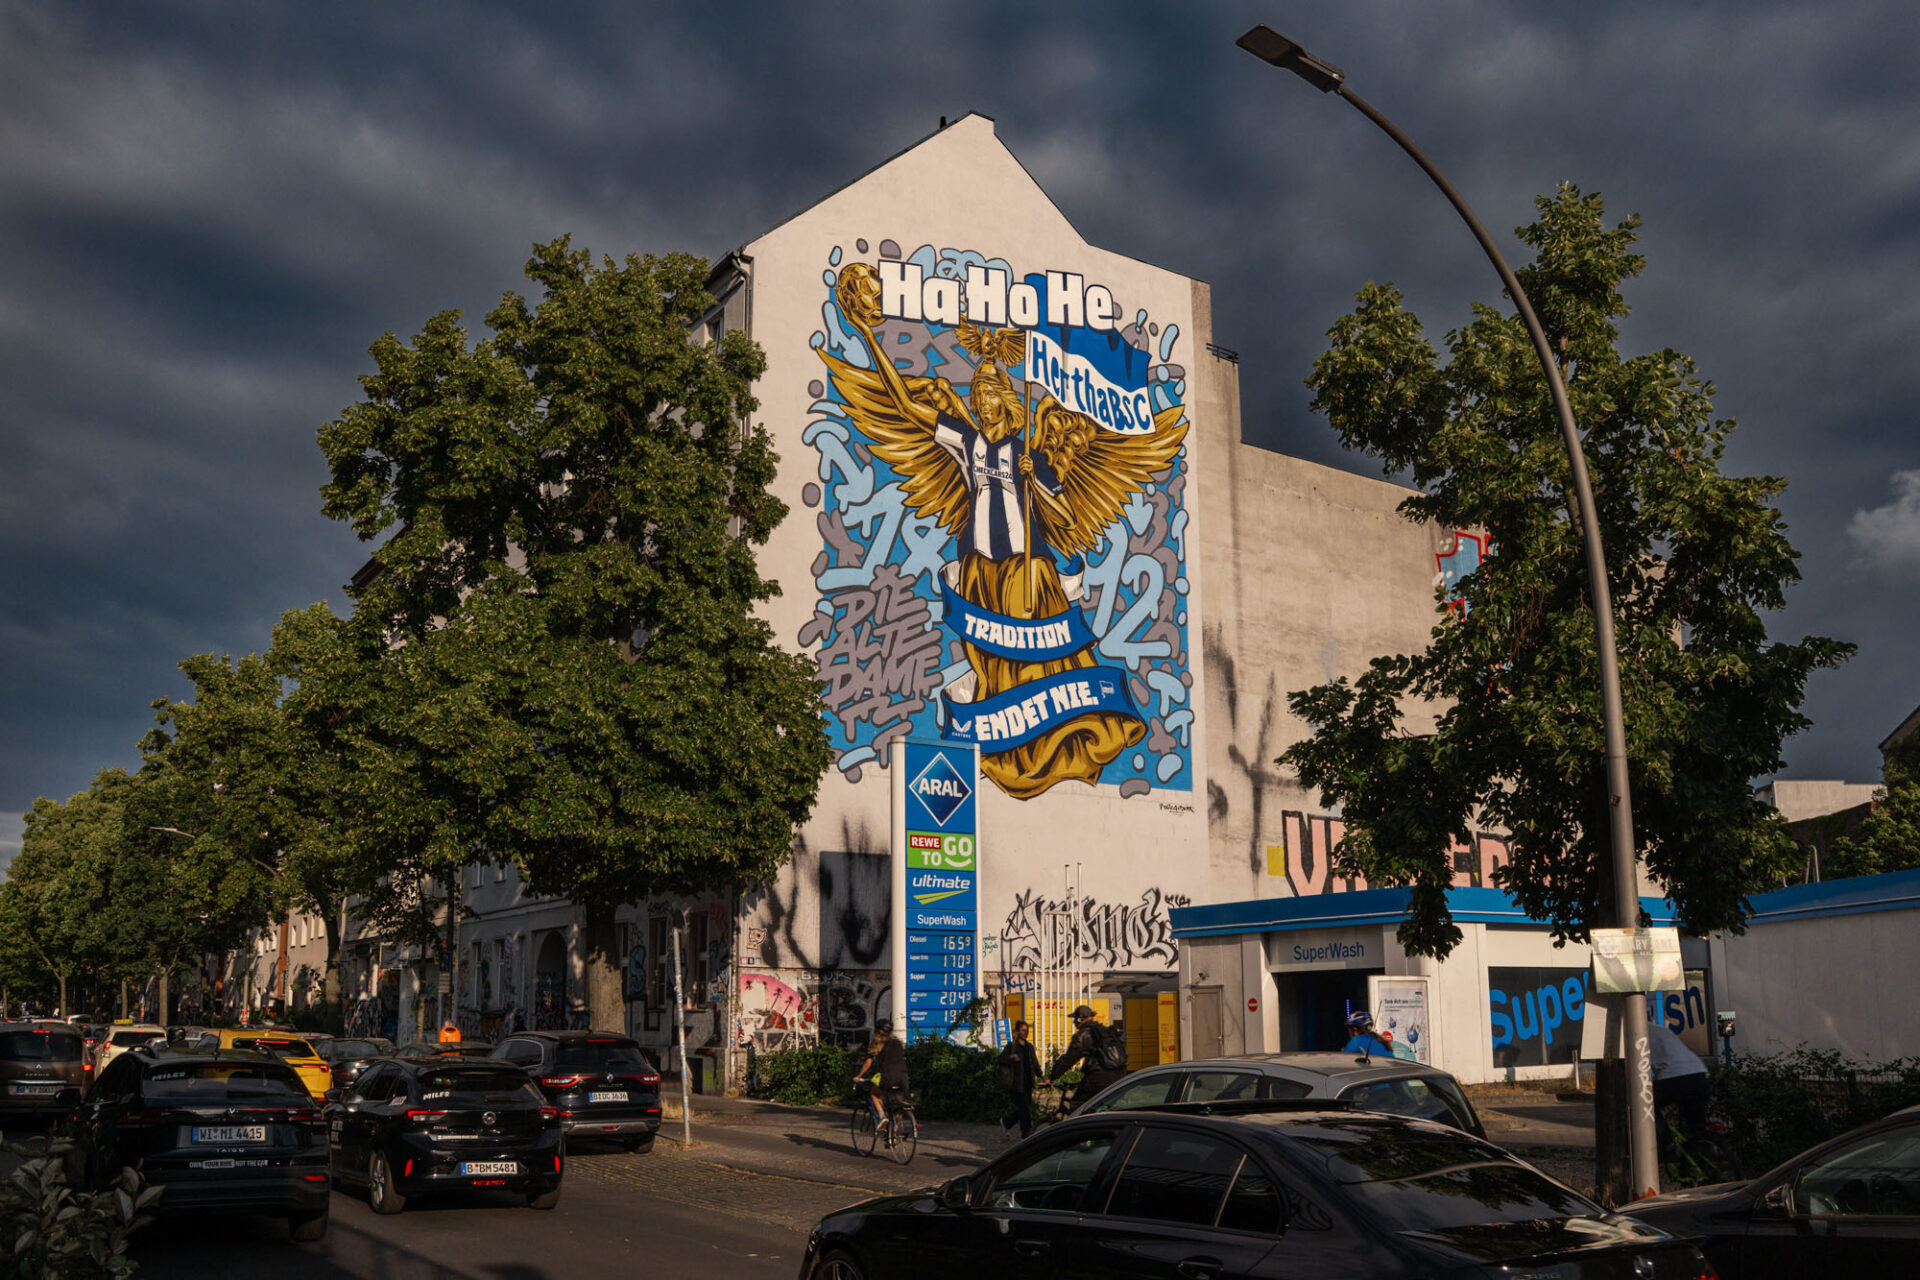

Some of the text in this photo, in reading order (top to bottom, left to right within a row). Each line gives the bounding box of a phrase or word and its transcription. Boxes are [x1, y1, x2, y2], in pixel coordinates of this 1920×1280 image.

[1045, 269, 1115, 333] He
[832, 568, 928, 633] DIE
[815, 611, 943, 668] ALTE
[964, 612, 1072, 649] TRADITION
[814, 645, 944, 712] DAME
[974, 681, 1099, 741] ENDET NIE.
[918, 778, 963, 798] ARAL
[911, 836, 973, 857] REWE GO
[921, 851, 942, 866] TO
[912, 874, 971, 890] ultimate
[917, 914, 967, 927] SuperWash
[909, 935, 927, 943] Diesel
[1293, 941, 1365, 963] SuperWash
[200, 1127, 262, 1140] WI MI 4415
[467, 1164, 473, 1173] B
